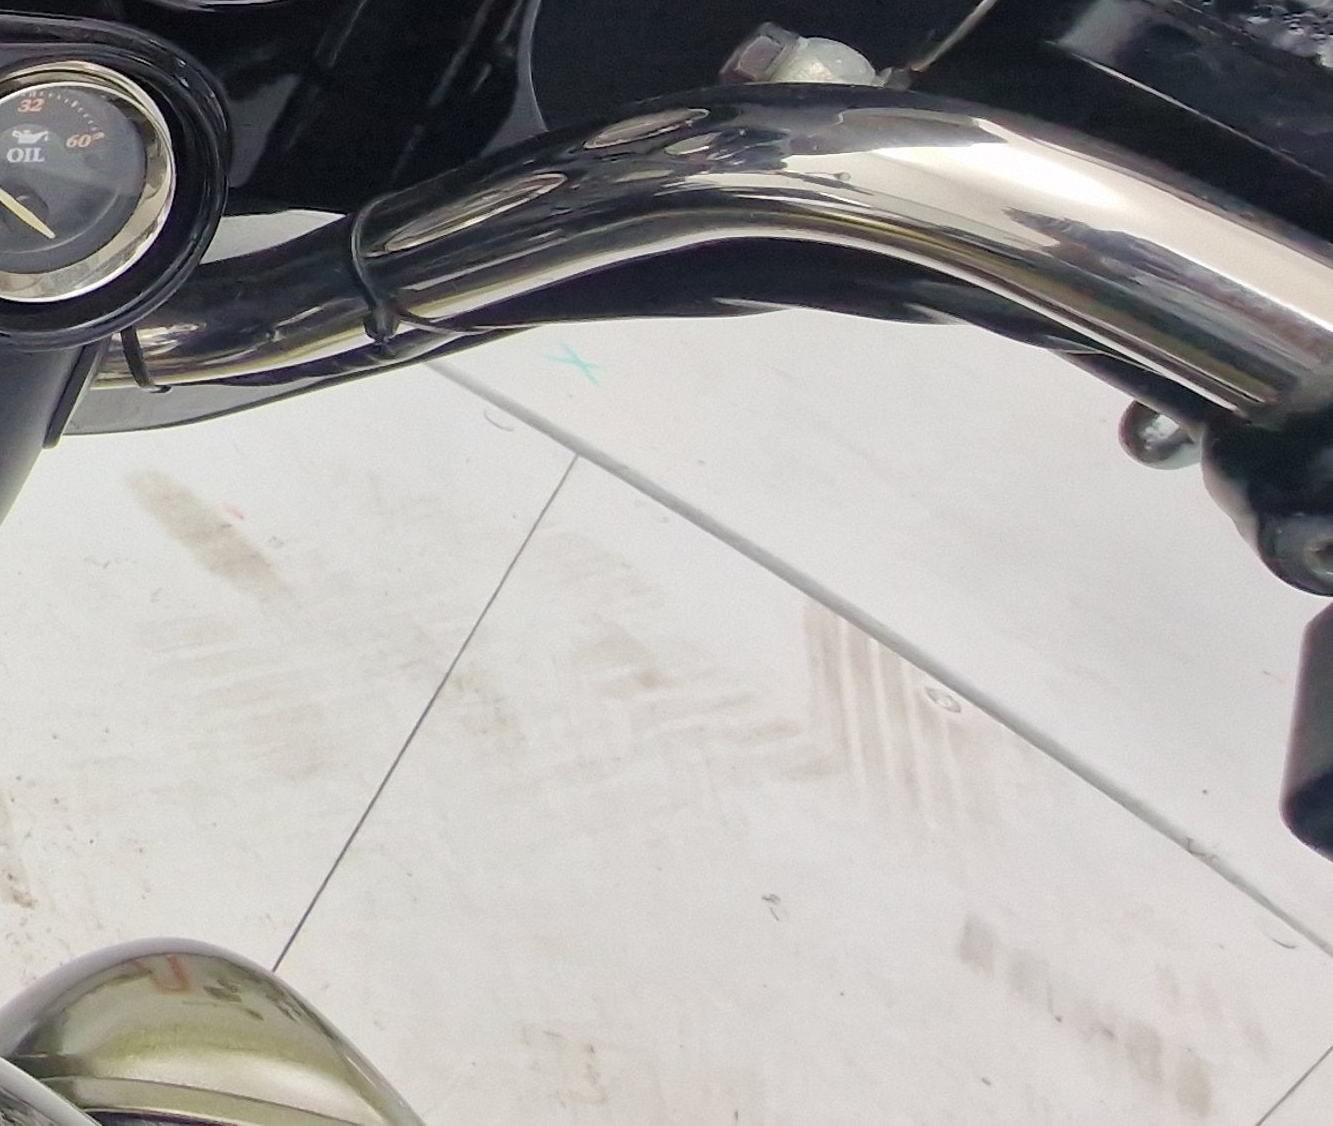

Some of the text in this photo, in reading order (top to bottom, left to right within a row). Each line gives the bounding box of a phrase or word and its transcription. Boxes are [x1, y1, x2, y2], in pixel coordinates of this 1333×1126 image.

[17, 99, 44, 113] 32
[65, 134, 92, 148] 60
[6, 147, 46, 163] OIL
